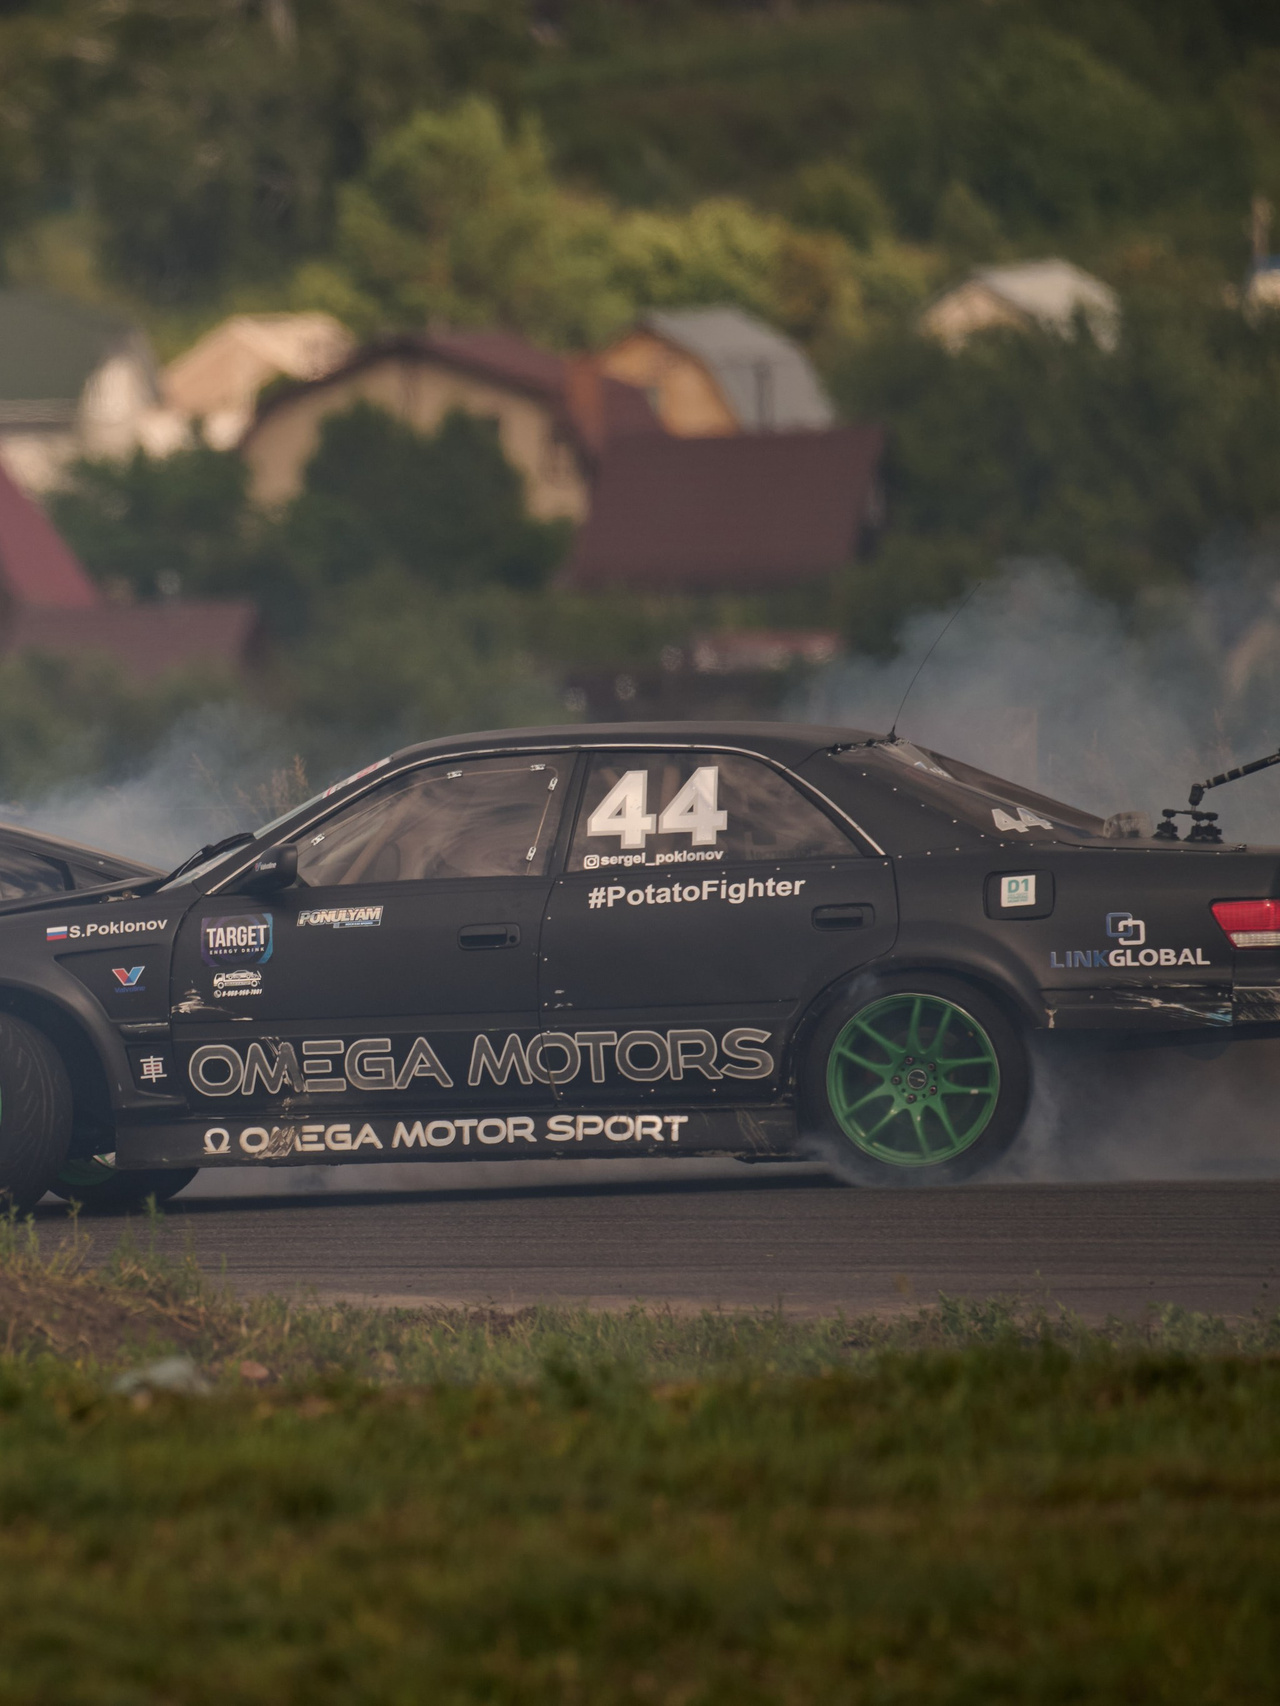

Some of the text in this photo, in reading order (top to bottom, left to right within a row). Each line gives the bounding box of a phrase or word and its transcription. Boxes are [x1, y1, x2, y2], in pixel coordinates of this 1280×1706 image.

[587, 766, 728, 849] 44
[991, 807, 1054, 833] 44
[588, 877, 806, 909] #PotatoFighter
[1007, 878, 1029, 894] D1
[69, 919, 168, 938] S.Poklonov
[298, 907, 382, 925] PONULYAM
[206, 924, 268, 949] TARGET
[209, 946, 265, 956] ENERGY DRINK
[140, 1055, 168, 1083] 車
[189, 1028, 775, 1096] OMEGA MOTORS
[392, 1116, 537, 1148] MOTOR
[545, 1114, 688, 1142] SPORT
